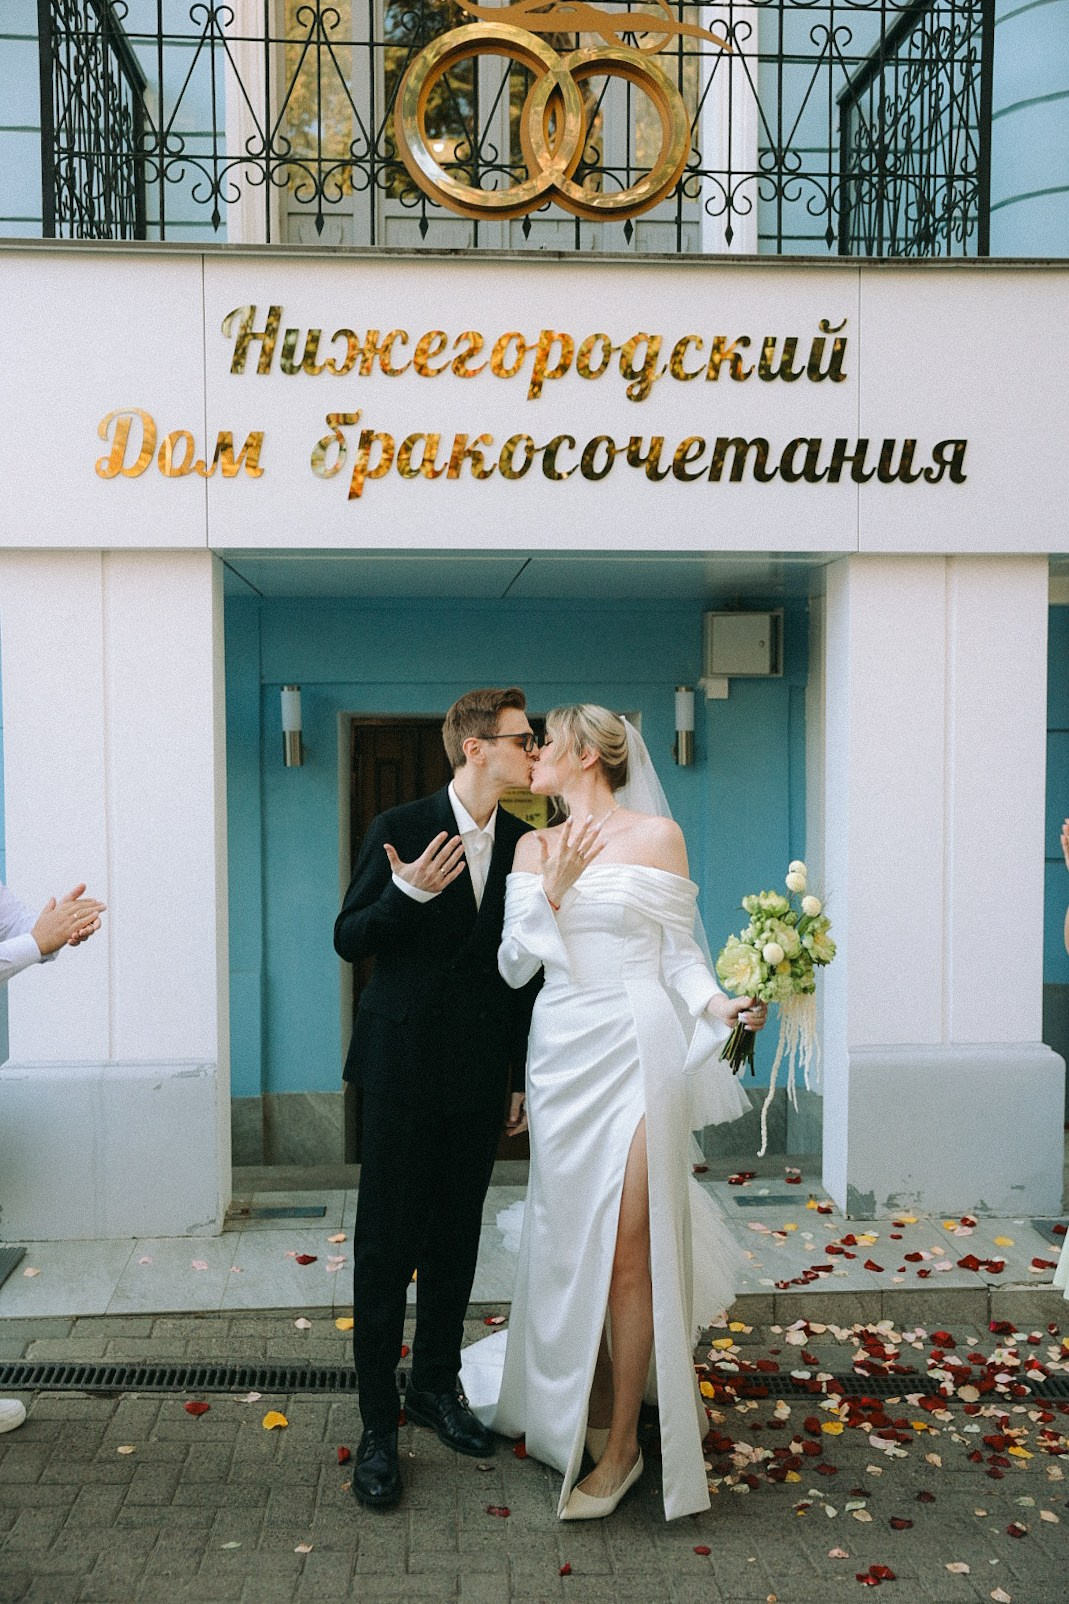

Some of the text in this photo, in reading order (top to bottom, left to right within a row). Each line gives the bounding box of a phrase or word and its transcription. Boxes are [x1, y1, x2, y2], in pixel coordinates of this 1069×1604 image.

[221, 304, 849, 402] Нижегородский
[95, 408, 969, 500] Дом бракосочетания
